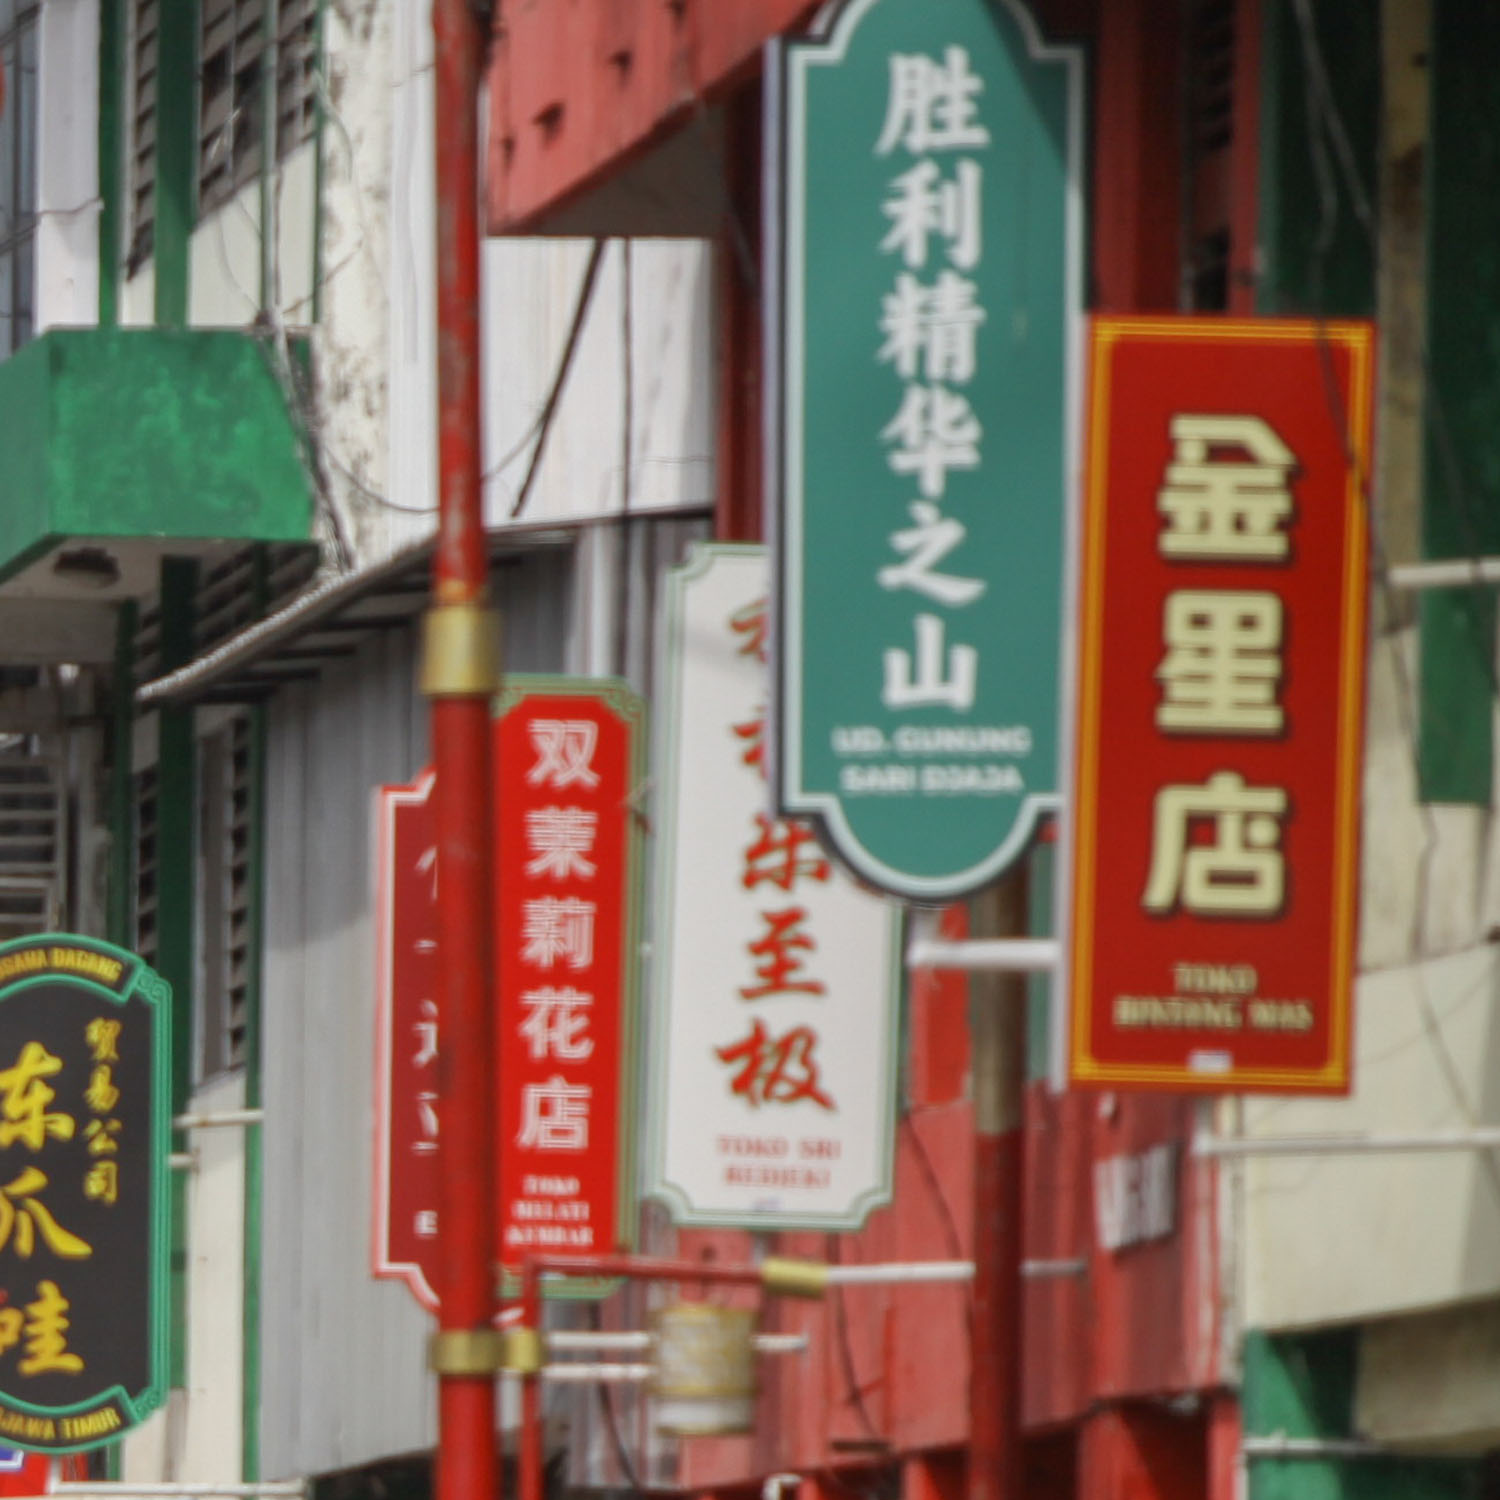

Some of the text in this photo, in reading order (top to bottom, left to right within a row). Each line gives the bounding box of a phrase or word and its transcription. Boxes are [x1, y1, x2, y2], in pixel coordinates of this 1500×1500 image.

[874, 44, 991, 710] 胜利精华之山
[893, 726, 1032, 757] GUNUNG
[53, 946, 123, 984] DAGANG
